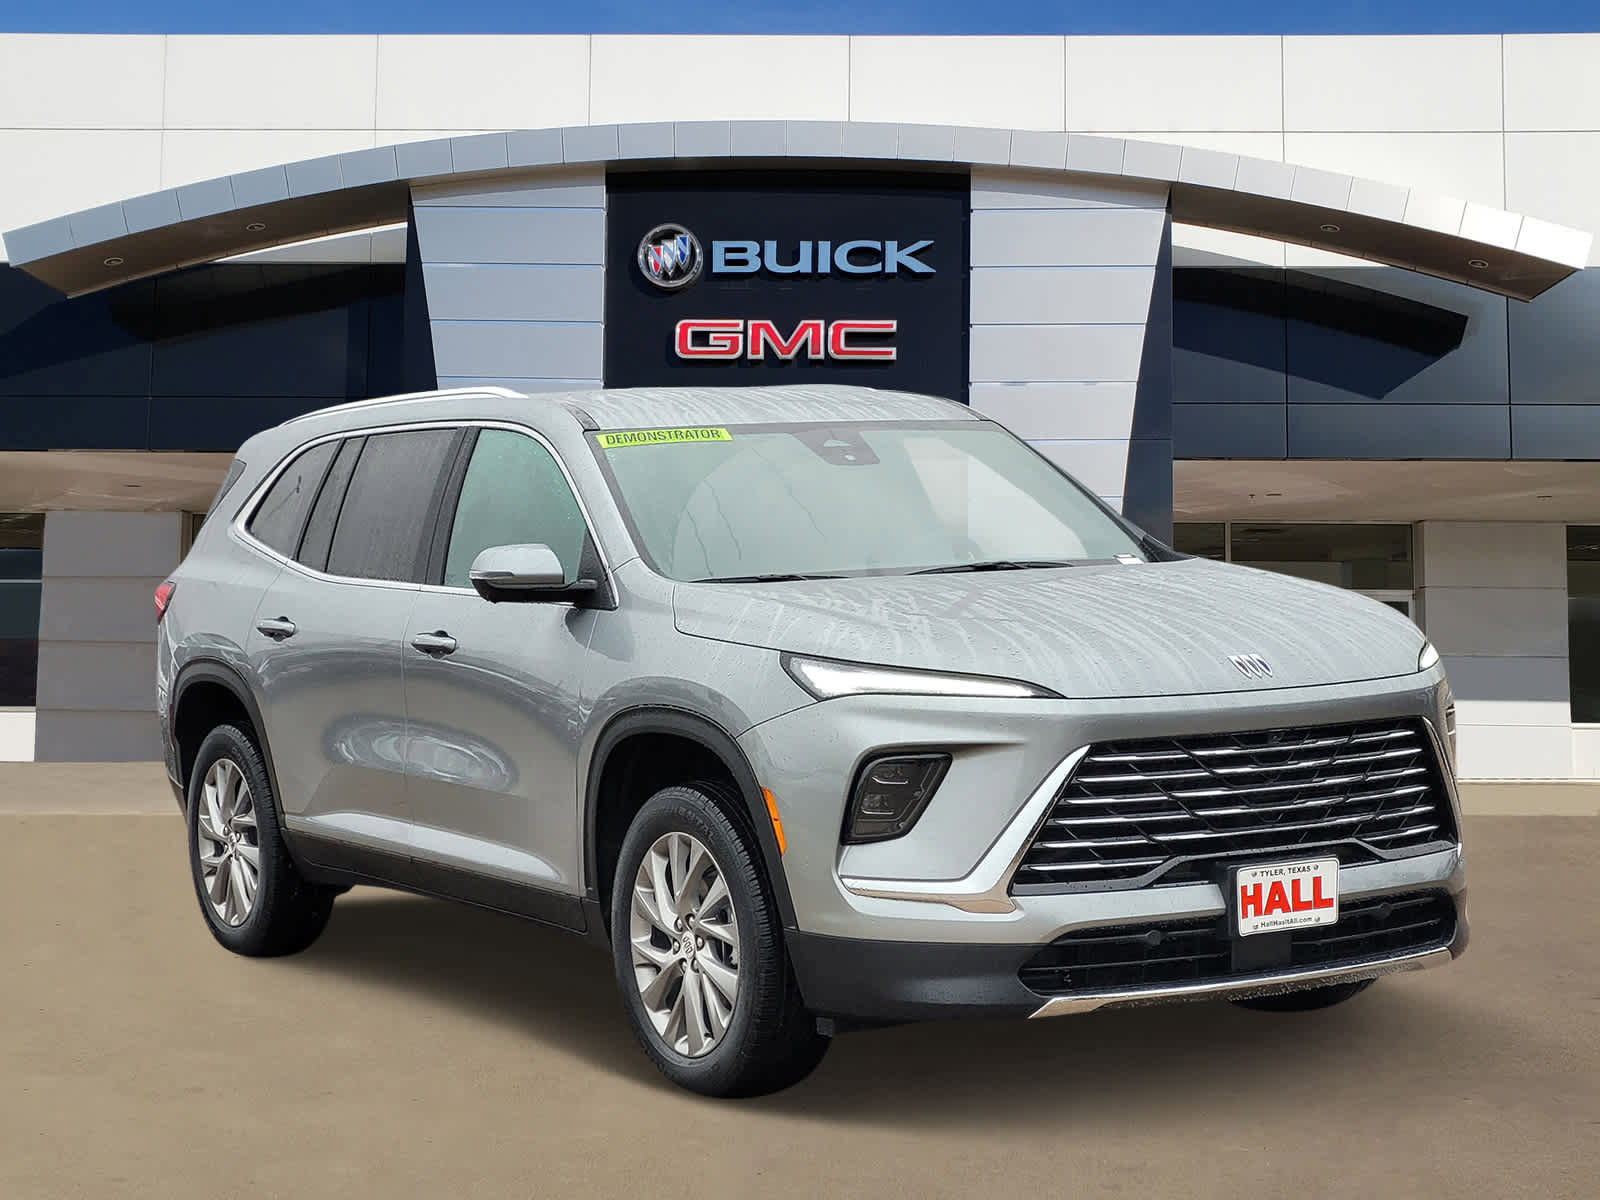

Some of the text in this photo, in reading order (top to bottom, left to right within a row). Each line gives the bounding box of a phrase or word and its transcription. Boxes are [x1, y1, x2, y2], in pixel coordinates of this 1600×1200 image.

[712, 240, 936, 273] BUICK
[675, 319, 897, 360] GMC
[605, 429, 721, 445] DEMONSTRATOR
[1260, 865, 1312, 877] TYLER, TEXAS
[1241, 876, 1334, 919] HALL
